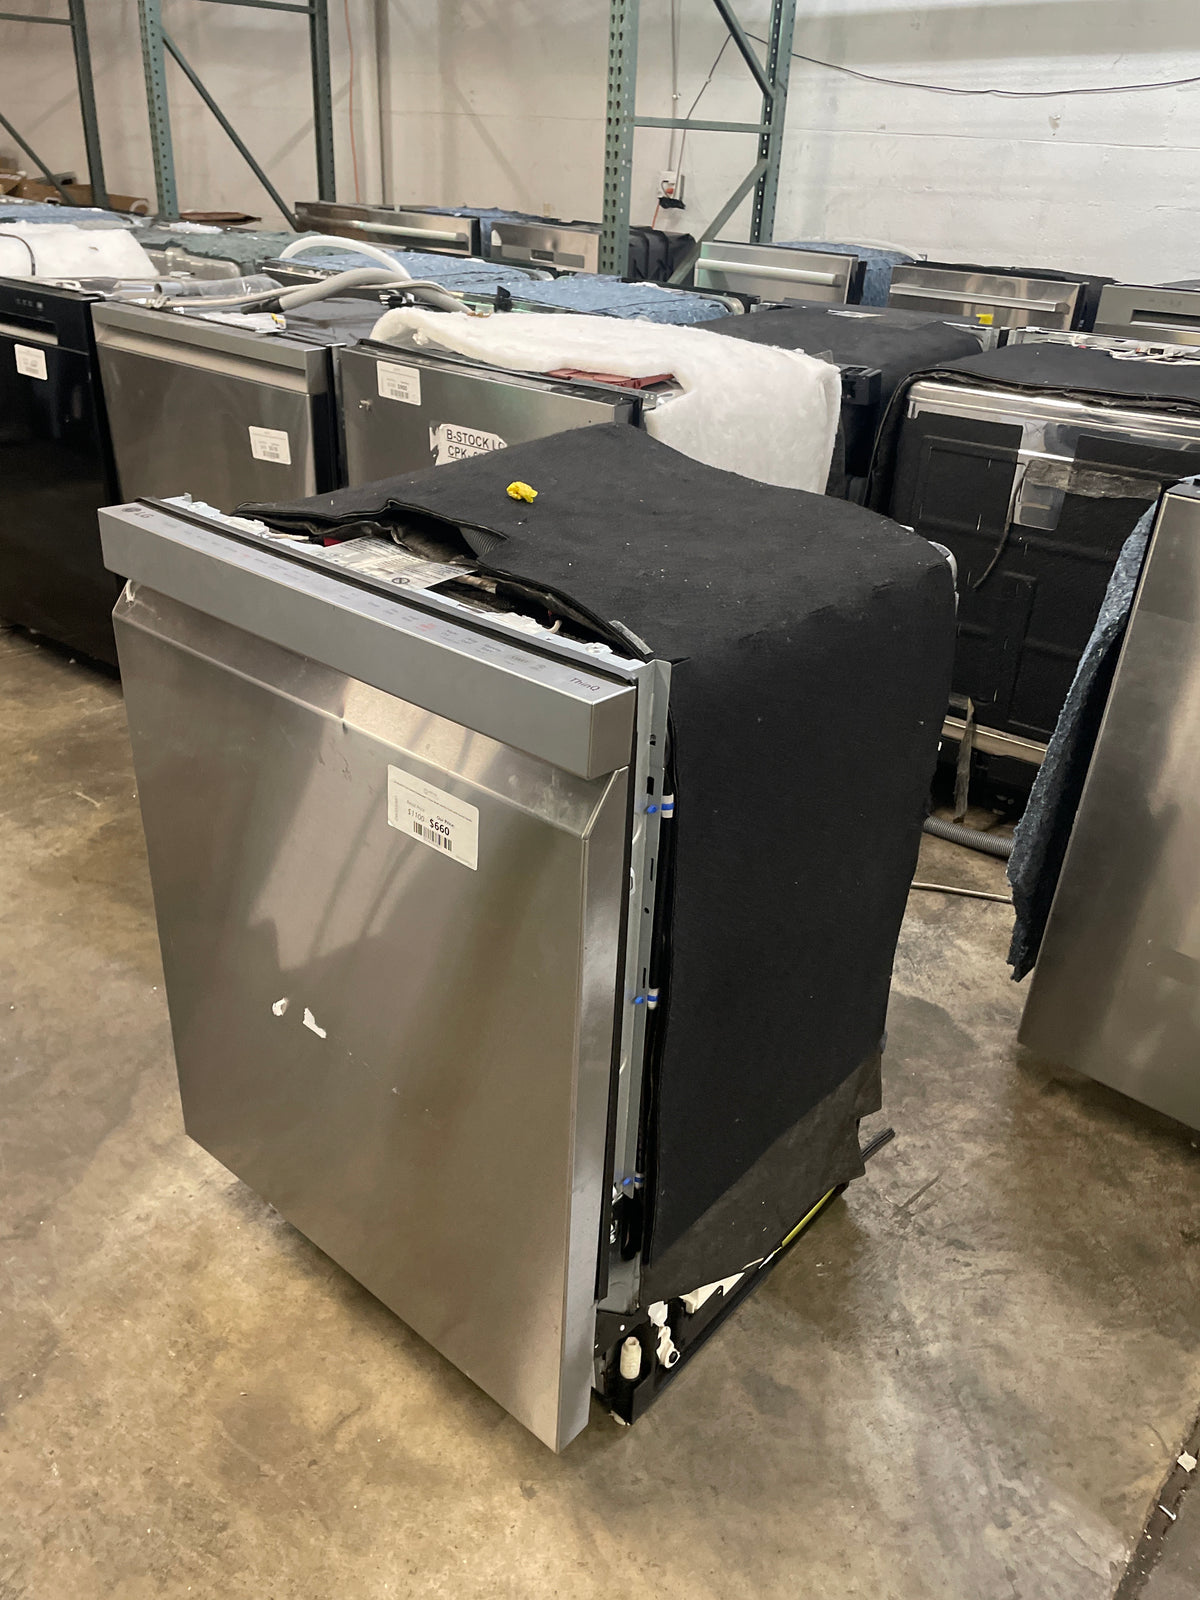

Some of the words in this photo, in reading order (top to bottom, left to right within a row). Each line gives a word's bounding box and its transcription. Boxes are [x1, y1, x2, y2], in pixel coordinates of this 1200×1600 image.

[446, 429, 489, 449] B-STOCK
[569, 677, 600, 692] ThinQ
[407, 808, 425, 822] $1100
[429, 818, 450, 836] $660
